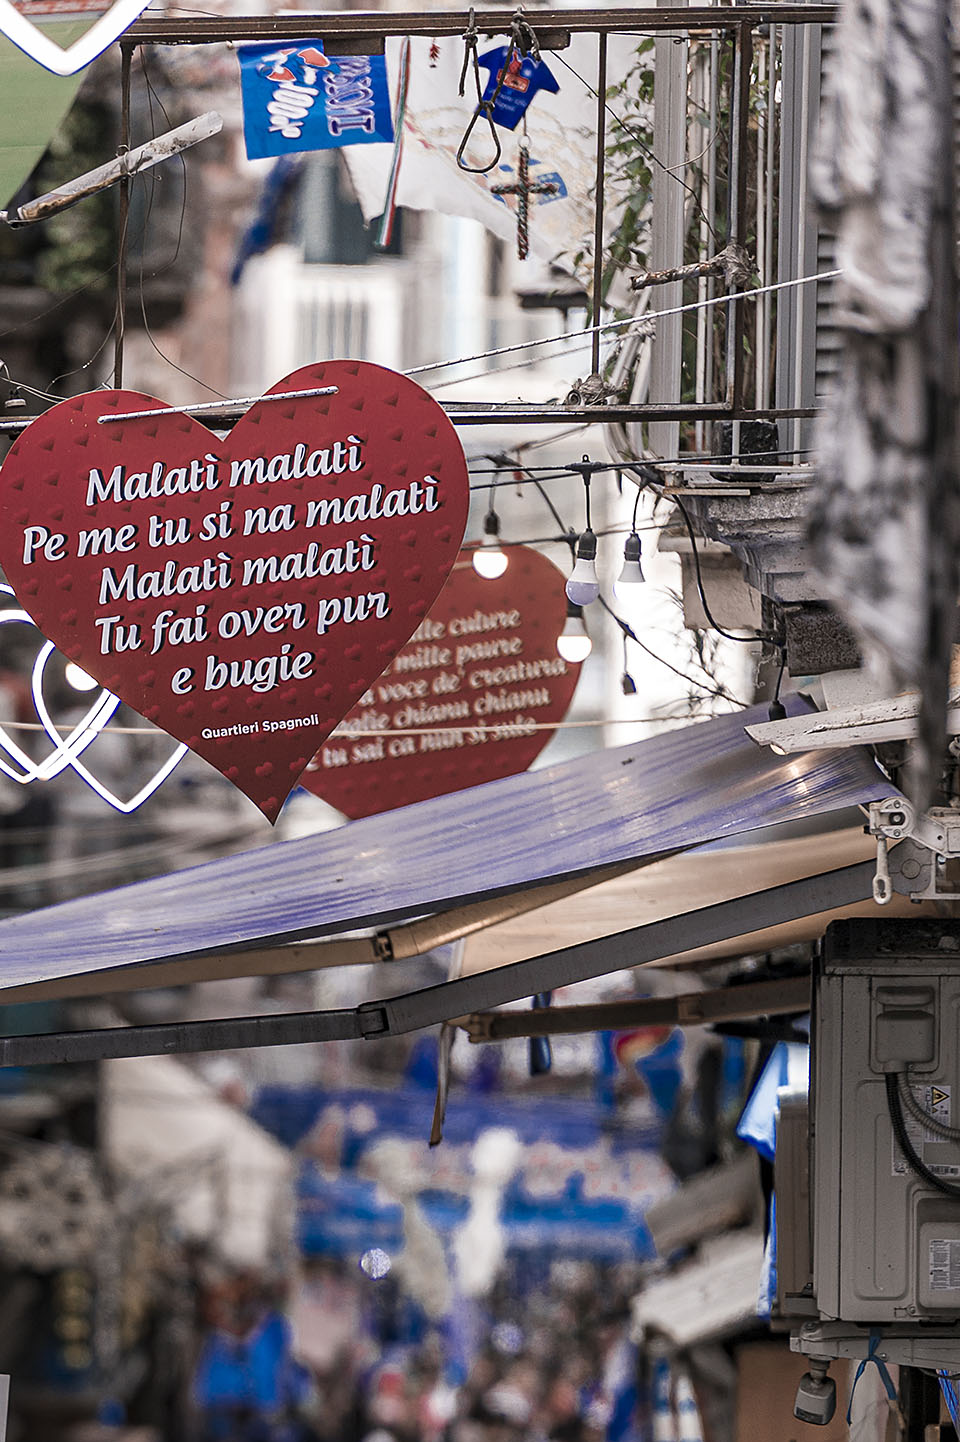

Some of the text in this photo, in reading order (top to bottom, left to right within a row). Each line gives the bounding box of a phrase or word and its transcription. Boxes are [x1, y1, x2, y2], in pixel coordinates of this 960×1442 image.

[84, 436, 363, 507] Malatì malatì
[21, 476, 440, 564] Pe me tu si na malatì
[97, 535, 376, 605] Malatì malatì
[95, 590, 391, 657] Tu fai over pur
[170, 647, 313, 696] e bugie
[201, 712, 320, 742] Quartieri Spagnoli
